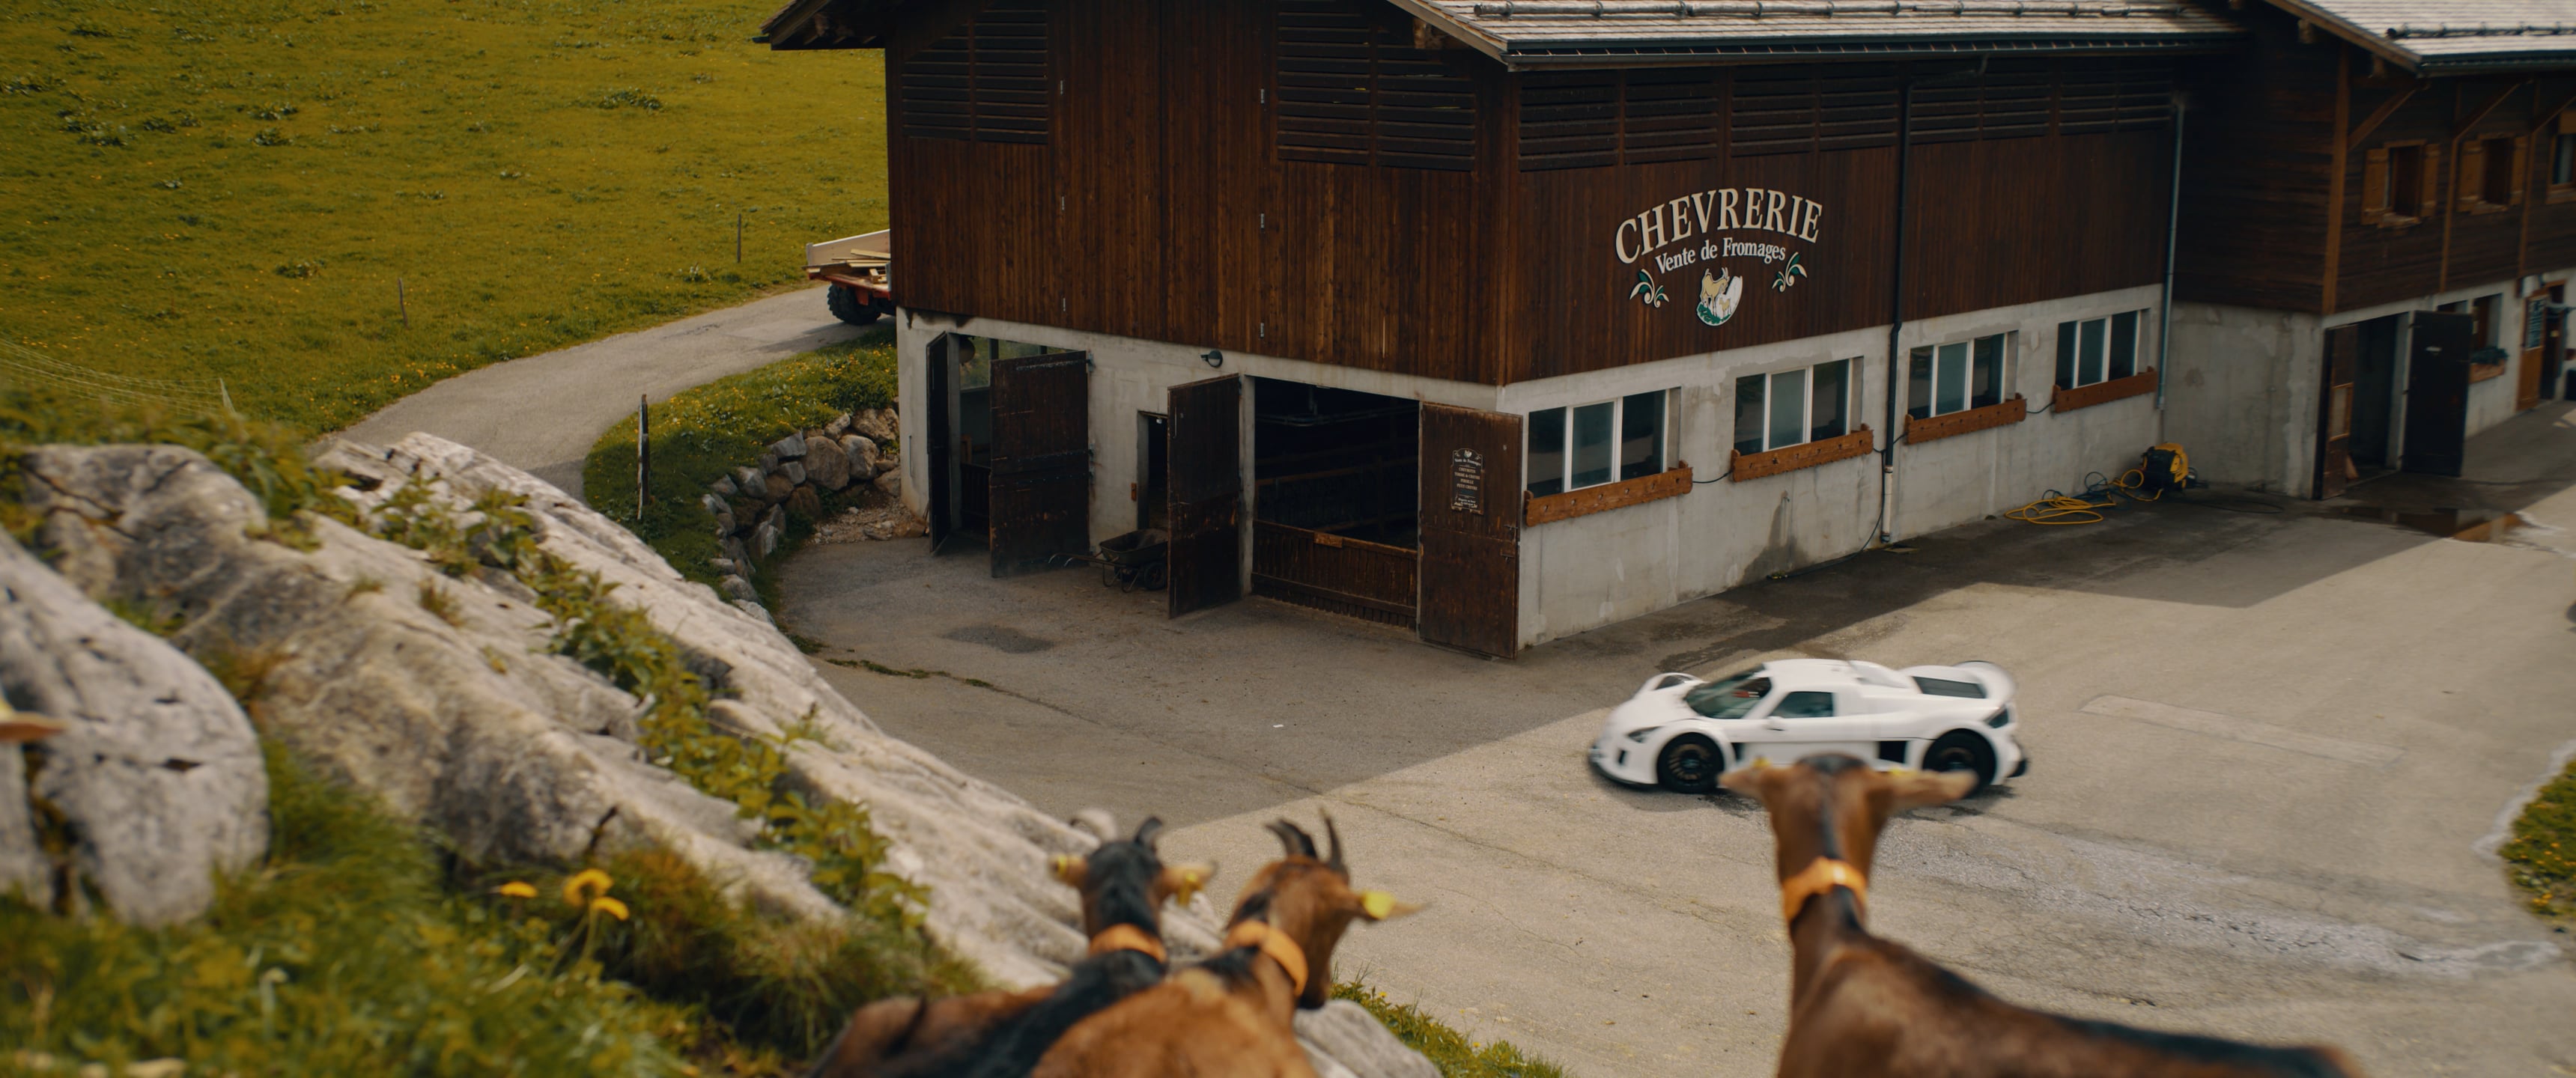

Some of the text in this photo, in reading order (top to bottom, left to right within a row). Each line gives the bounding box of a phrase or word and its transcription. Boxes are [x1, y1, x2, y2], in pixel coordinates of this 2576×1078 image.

[1615, 187, 1823, 264] CHEVRERIE
[1655, 237, 1786, 275] Vente de Fromages
